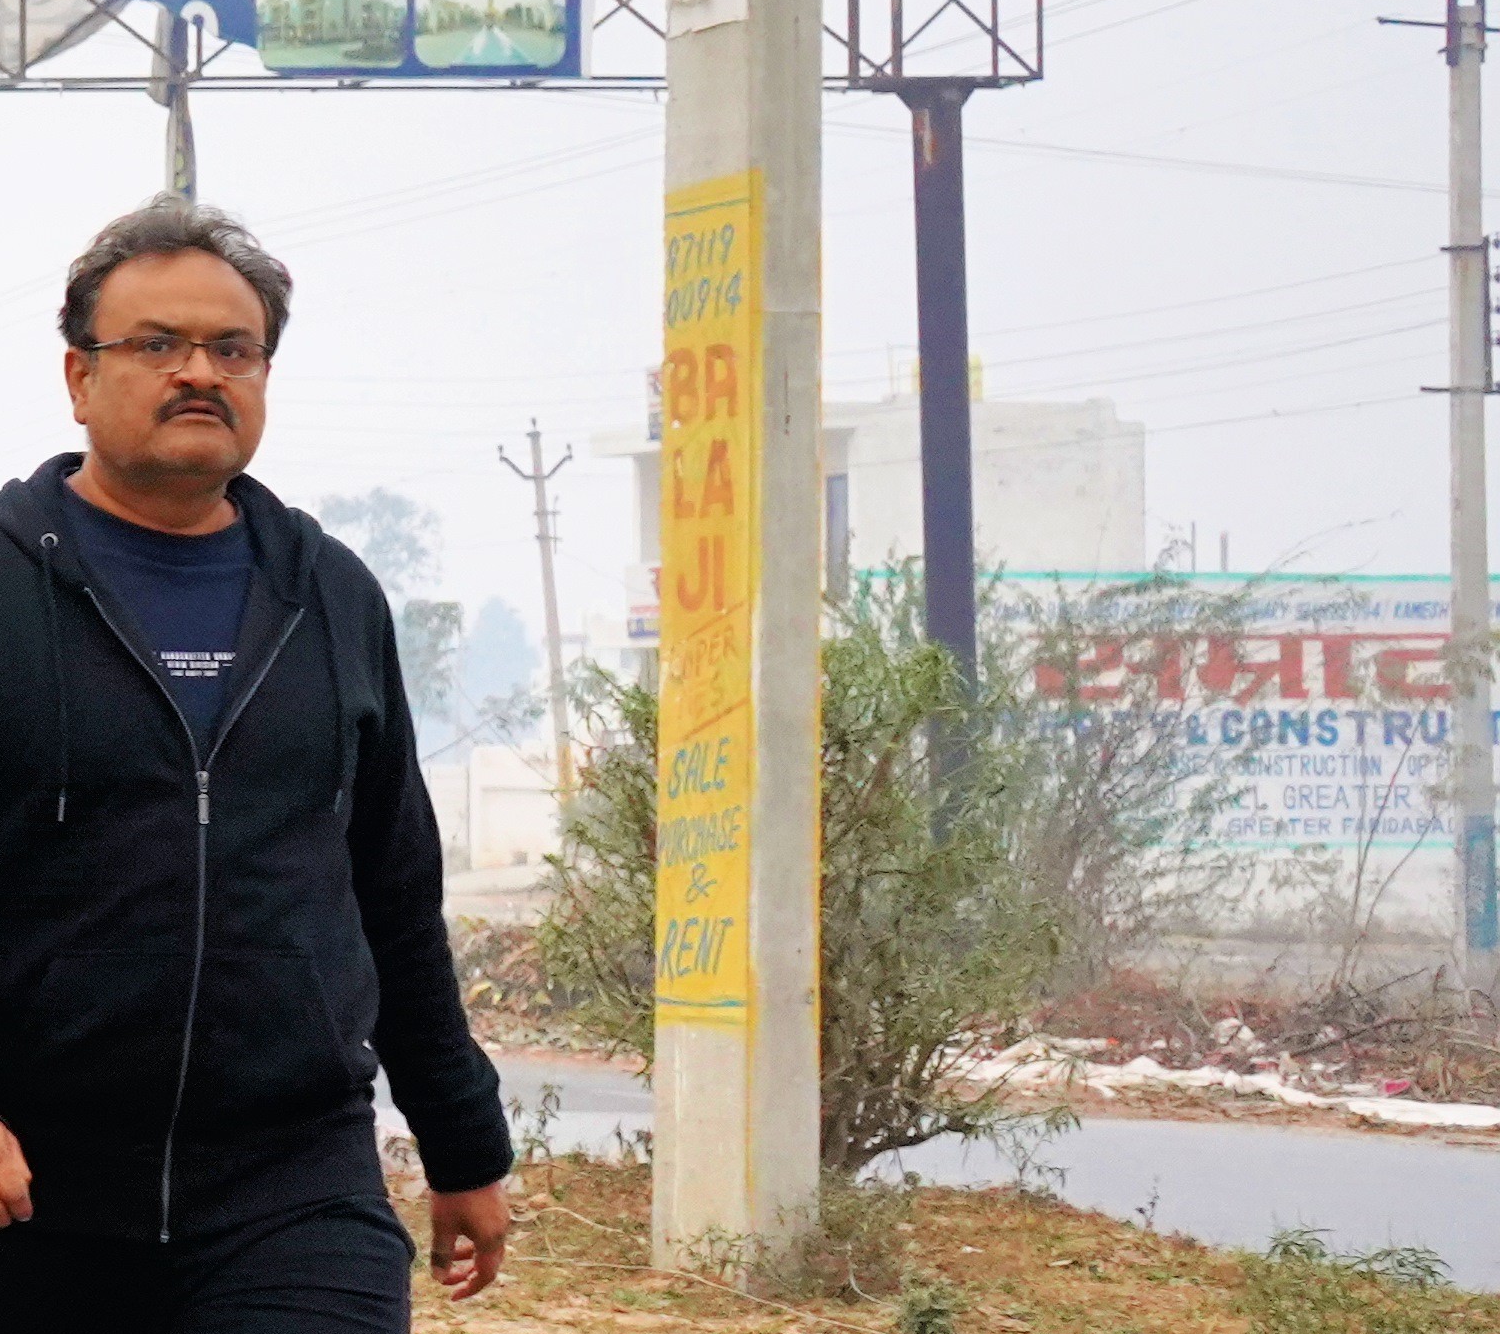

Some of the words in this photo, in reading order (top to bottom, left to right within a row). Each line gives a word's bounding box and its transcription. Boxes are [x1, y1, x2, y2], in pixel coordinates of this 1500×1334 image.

[663, 342, 740, 427] BA
[672, 436, 736, 521] LA
[675, 534, 726, 614] JI
[667, 735, 731, 800] SALE
[1283, 784, 1412, 811] GREATER
[1227, 817, 1331, 836] GREATER
[685, 863, 718, 904] &
[658, 916, 734, 984] RENT
